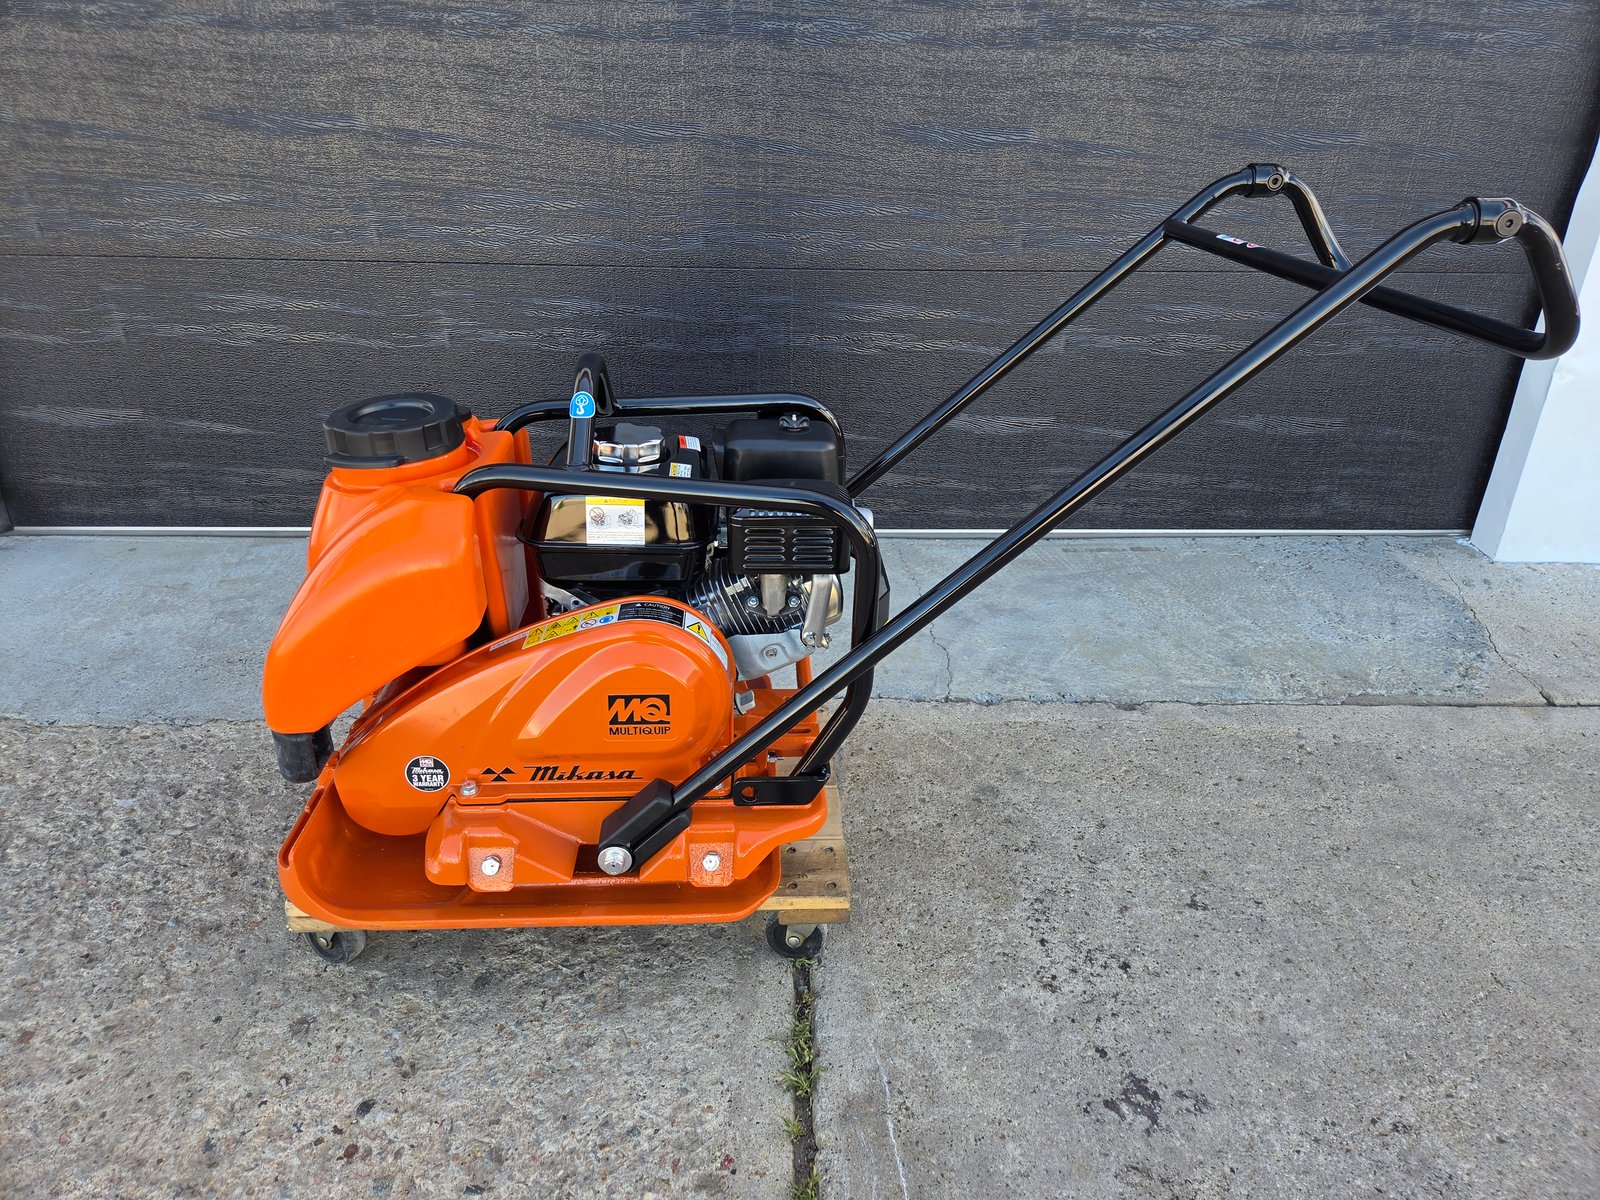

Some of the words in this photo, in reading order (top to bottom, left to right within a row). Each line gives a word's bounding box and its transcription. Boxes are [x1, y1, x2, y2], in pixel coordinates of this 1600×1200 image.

[608, 695, 670, 723] MQ
[609, 726, 671, 736] MULTIQUIP
[524, 764, 643, 782] Mikasa
